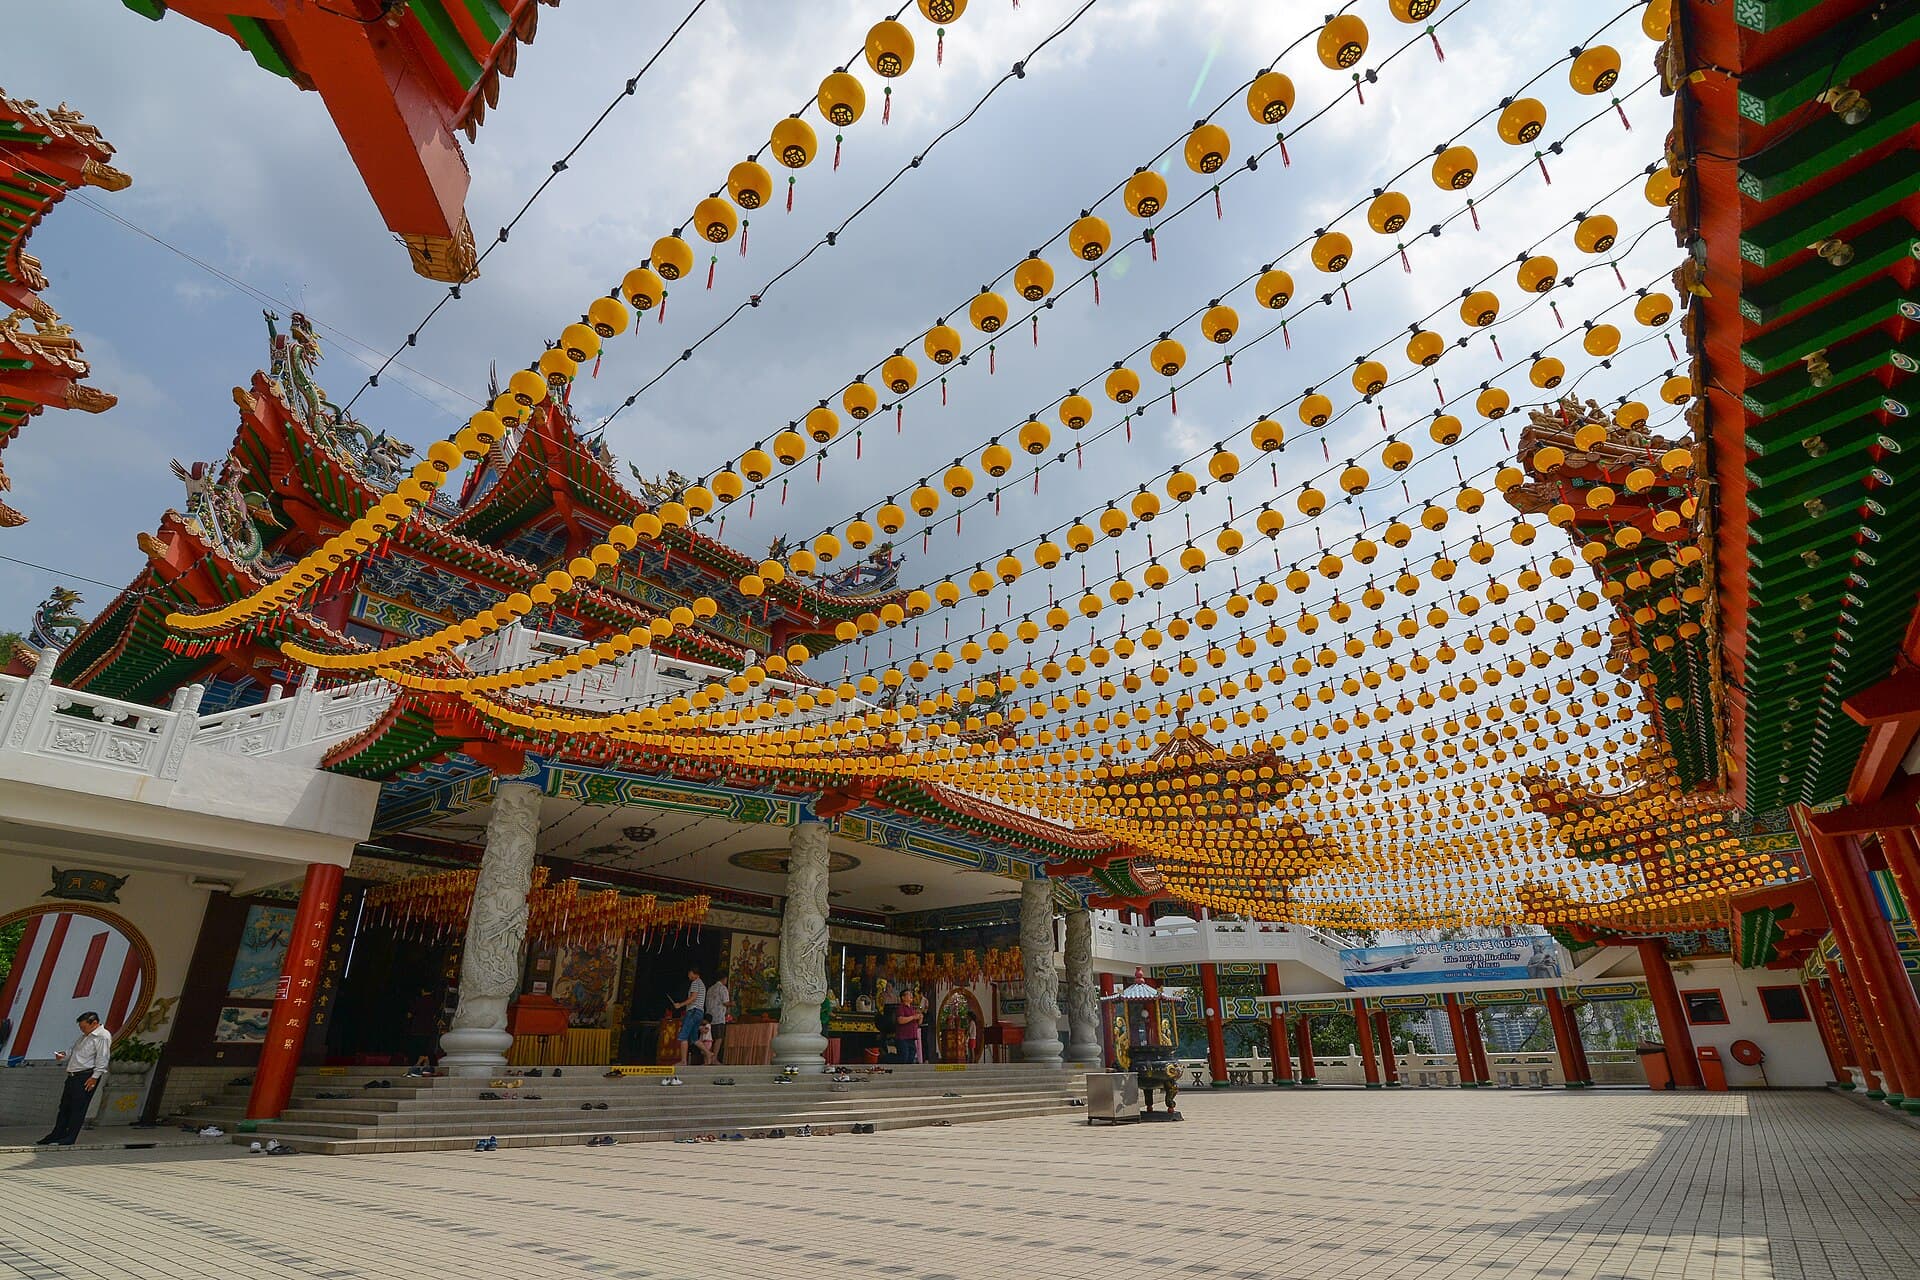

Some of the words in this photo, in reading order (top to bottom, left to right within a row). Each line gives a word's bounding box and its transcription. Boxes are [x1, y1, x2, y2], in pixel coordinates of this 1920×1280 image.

[1443, 955, 1458, 964] The
[1485, 952, 1521, 962] Birthday
[1466, 962, 1475, 970] of
